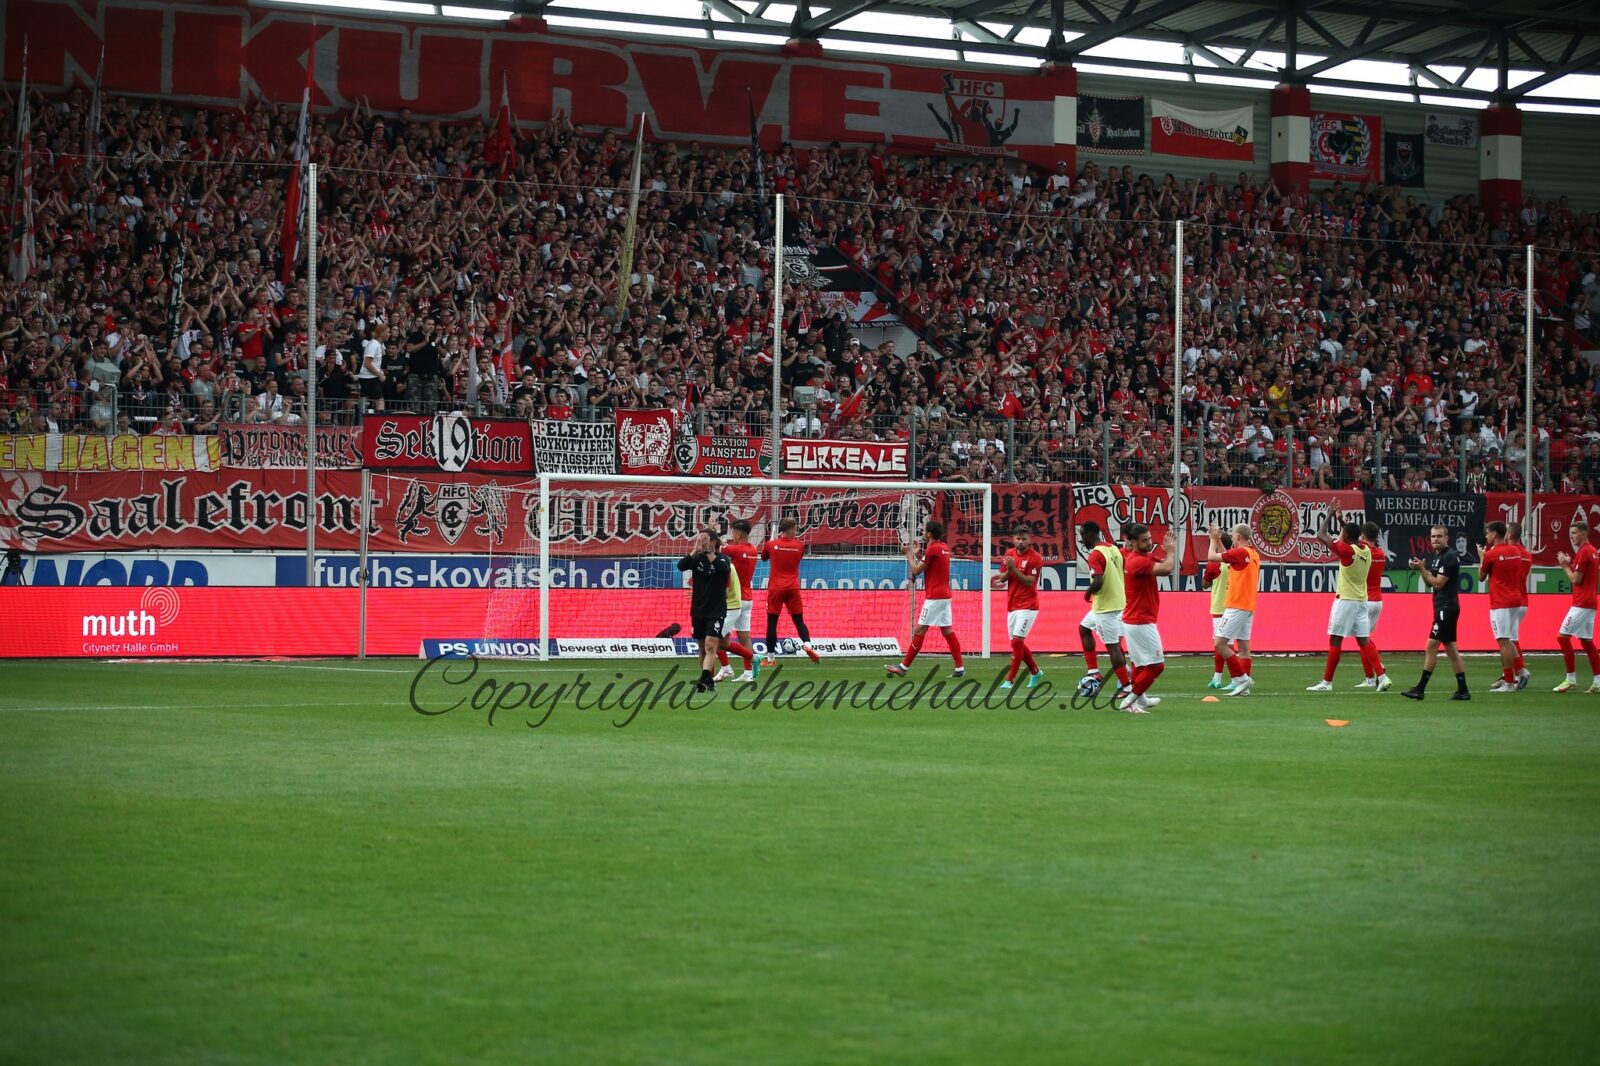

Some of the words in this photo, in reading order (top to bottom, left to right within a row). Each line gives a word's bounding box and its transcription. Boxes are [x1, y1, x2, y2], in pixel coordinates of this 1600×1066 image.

[960, 80, 995, 95] HFC
[533, 421, 615, 438] TELEKOM
[711, 437, 748, 446] SEKTION
[57, 434, 197, 472] JAGEN
[702, 447, 756, 459] MANSFELD
[786, 445, 908, 472] SURREALE
[704, 461, 752, 476] SÜDHARZ
[442, 484, 466, 498] HFC
[1074, 487, 1108, 504] HFC
[1255, 493, 1296, 514] HALLESCHER
[1375, 497, 1475, 512] MERSEBURGER
[1384, 513, 1466, 527] DOMFALKEN
[1297, 541, 1331, 559] 1984
[313, 558, 641, 589] fuchs-kovatsch.de
[82, 610, 156, 636] muth
[82, 643, 120, 654] Citynetz
[122, 643, 147, 652] Halle
[149, 643, 178, 652] GmbH
[438, 642, 469, 656] PS
[559, 641, 607, 653] bewegt
[610, 641, 628, 652] die
[631, 642, 673, 654] Region
[840, 641, 857, 652] die
[859, 642, 898, 652] Region
